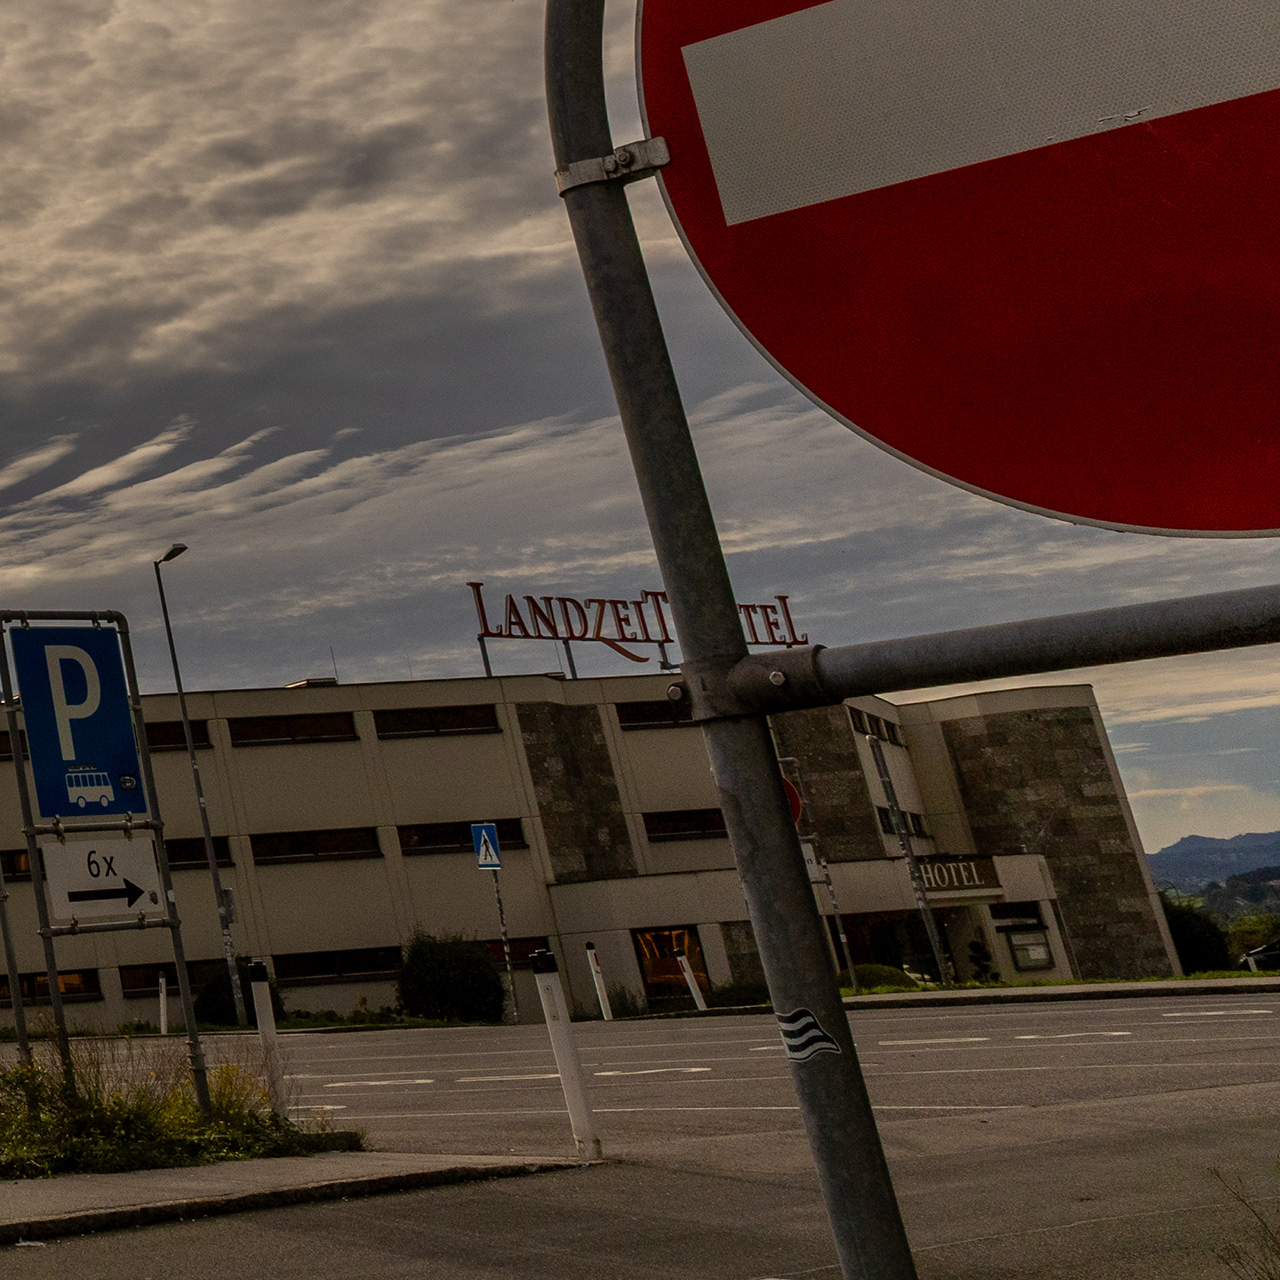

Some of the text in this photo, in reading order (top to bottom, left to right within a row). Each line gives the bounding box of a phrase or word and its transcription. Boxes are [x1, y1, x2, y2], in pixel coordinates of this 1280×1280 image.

[466, 582, 809, 662] LANDZEIT TEL
[44, 645, 102, 761] P
[87, 850, 118, 878] 6x
[919, 862, 985, 888] HOTEL
